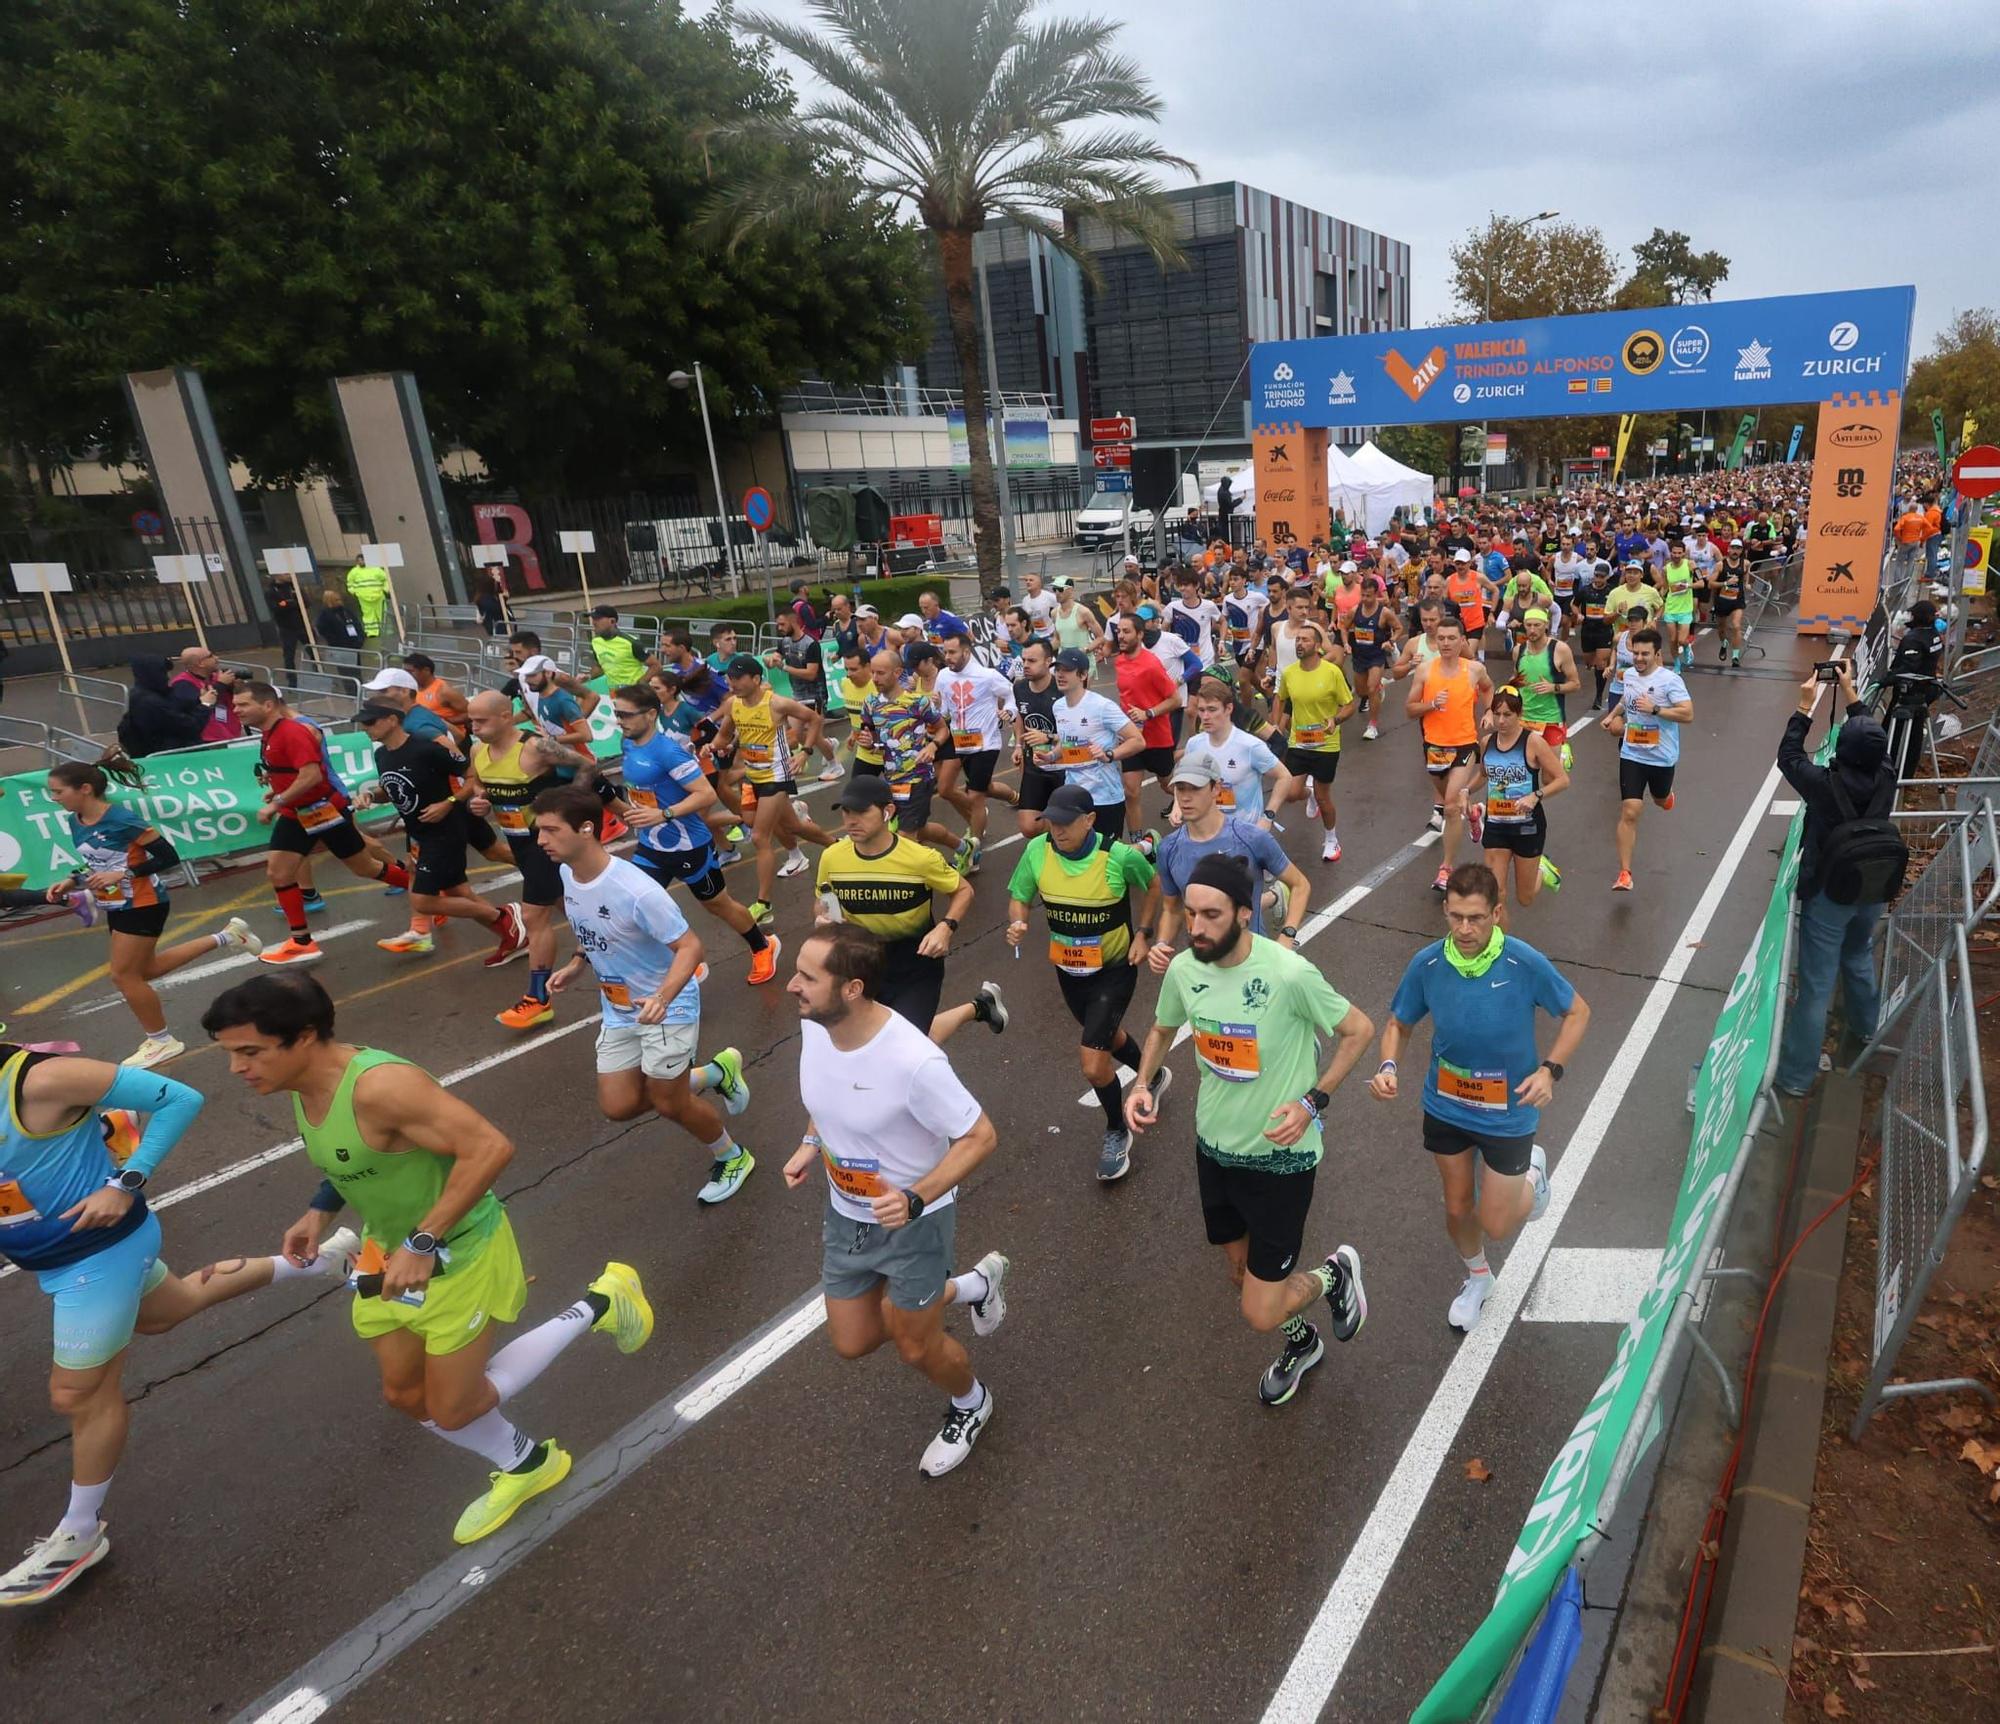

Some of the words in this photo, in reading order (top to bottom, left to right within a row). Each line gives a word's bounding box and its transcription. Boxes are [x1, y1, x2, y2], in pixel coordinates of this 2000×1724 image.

[1454, 339, 1527, 360] VALENCIA
[1677, 339, 1703, 348] SUPER
[1676, 347, 1702, 355] HALFS
[1454, 360, 1529, 380] TRINIDAD
[1533, 355, 1615, 375] ALFONSO
[1802, 357, 1881, 377] ZURICH
[1412, 357, 1440, 393] 21K
[1734, 369, 1772, 381] luanvi
[1264, 381, 1305, 390] FUNDACIÓN
[1476, 384, 1525, 399] ZURICH
[1264, 389, 1305, 400] TRINIDAD
[1265, 399, 1305, 408] ALFONSO
[1833, 430, 1878, 443] ASTURIANA
[1816, 584, 1860, 595] CaixaBank
[1487, 765, 1527, 777] EGAN
[834, 888, 916, 901] ORRECAMINOS
[1208, 1038, 1234, 1053] 6079
[1215, 1055, 1231, 1067] BYK
[1456, 1079, 1483, 1091] 5945
